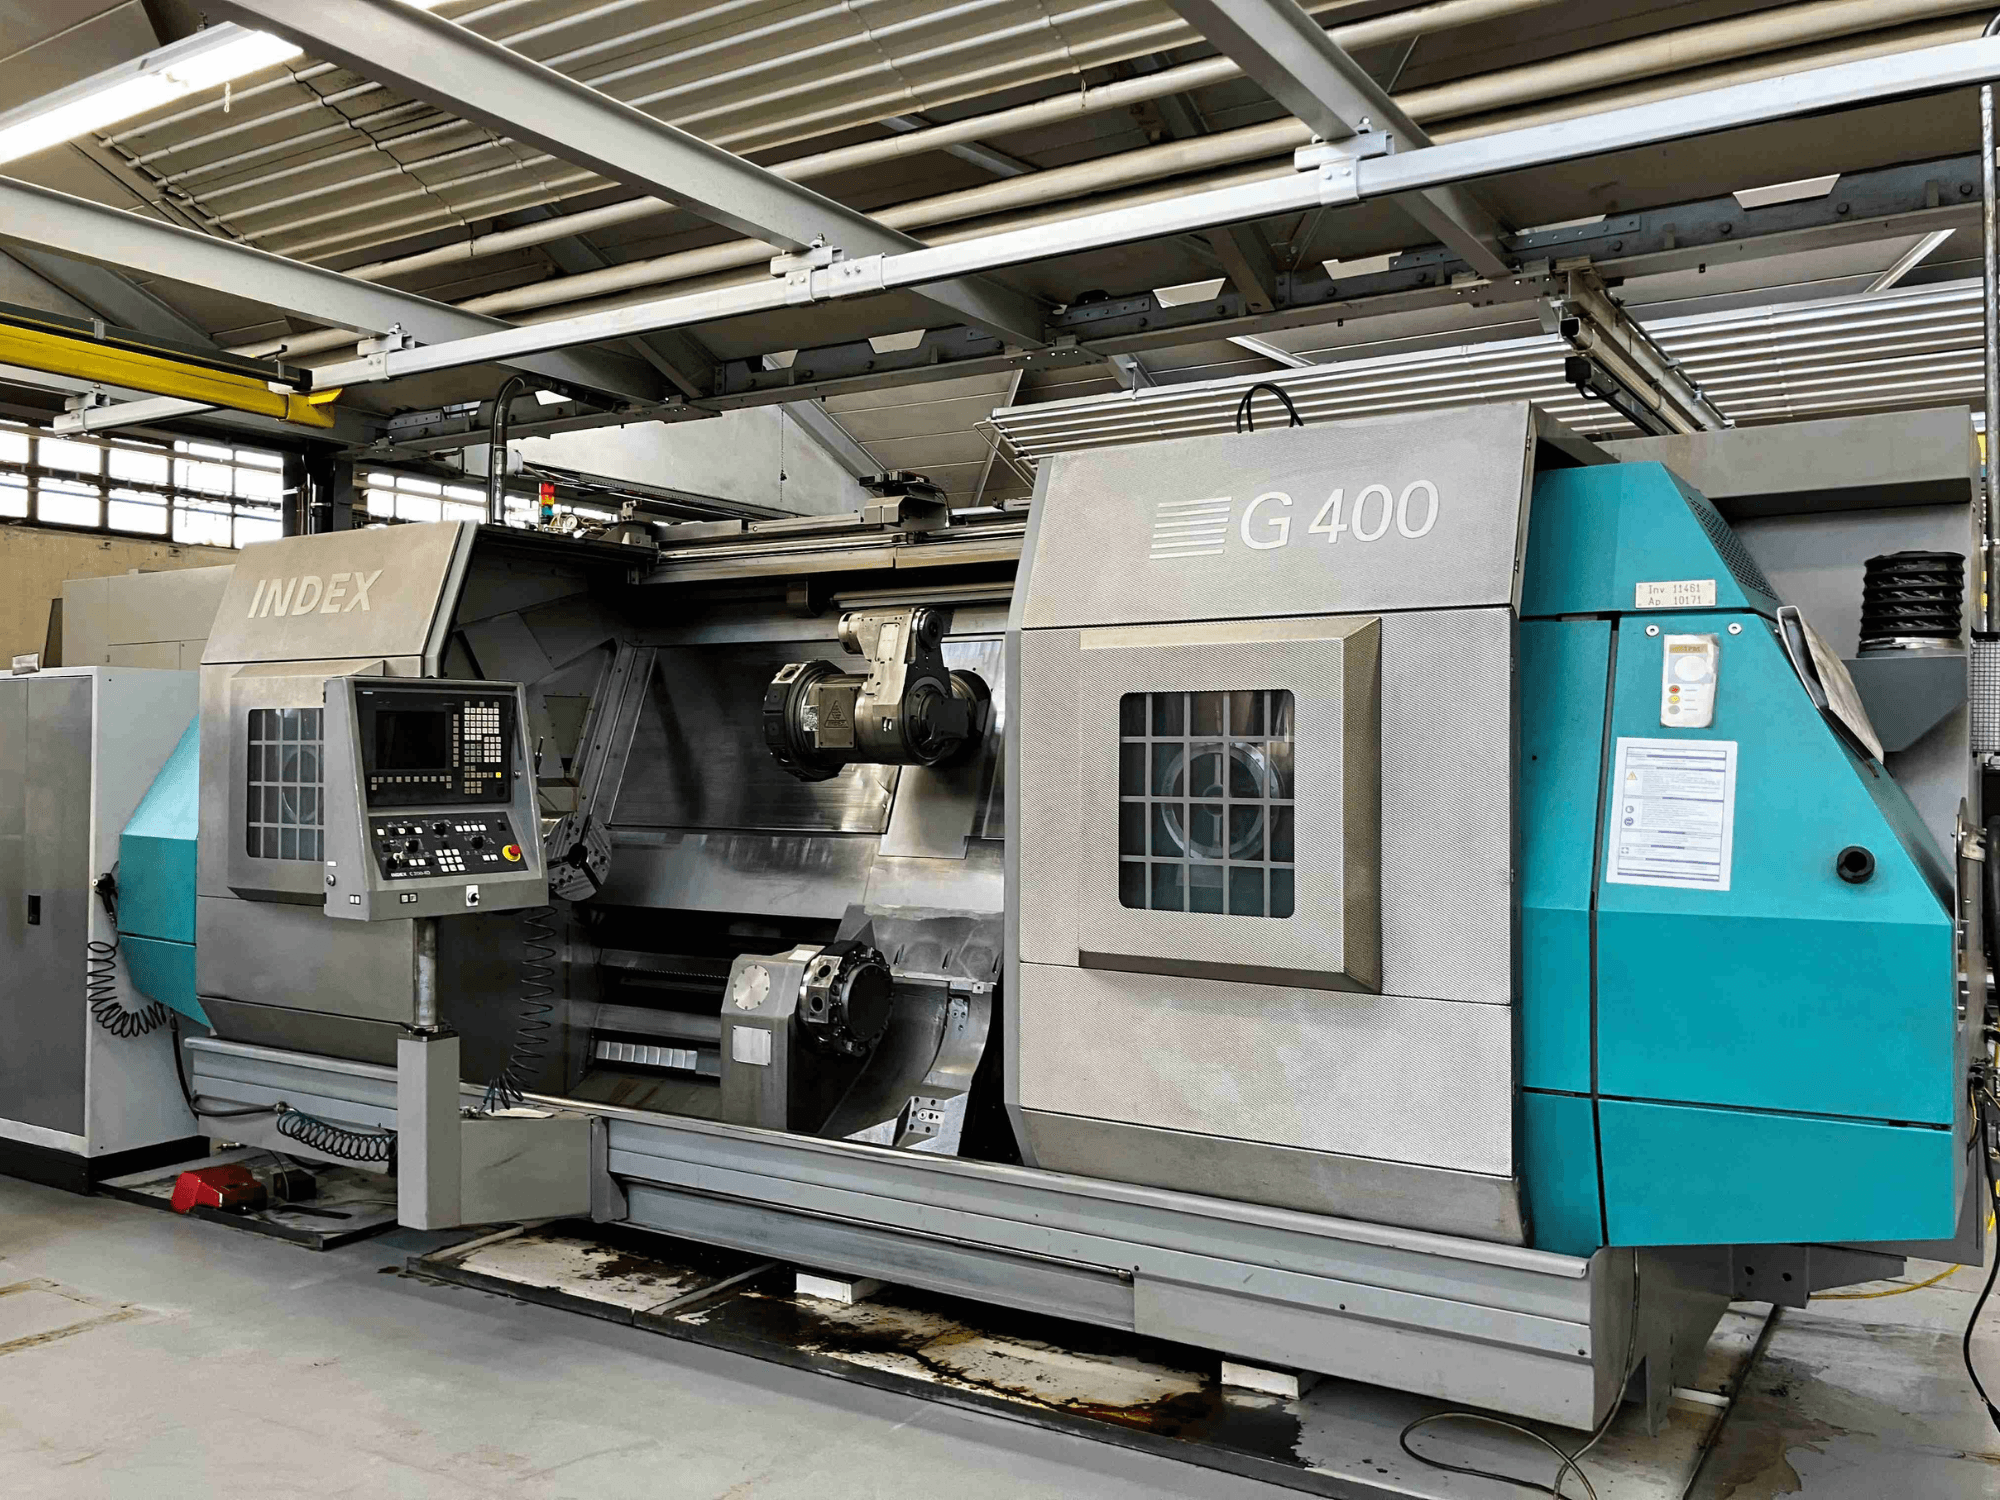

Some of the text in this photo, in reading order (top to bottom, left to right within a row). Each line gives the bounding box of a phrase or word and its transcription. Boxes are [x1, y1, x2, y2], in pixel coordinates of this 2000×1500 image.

[1240, 479, 1440, 551] G 400
[247, 569, 384, 619] INDEX
[1673, 583, 1701, 594] 11461
[1674, 595, 1702, 606] 10171
